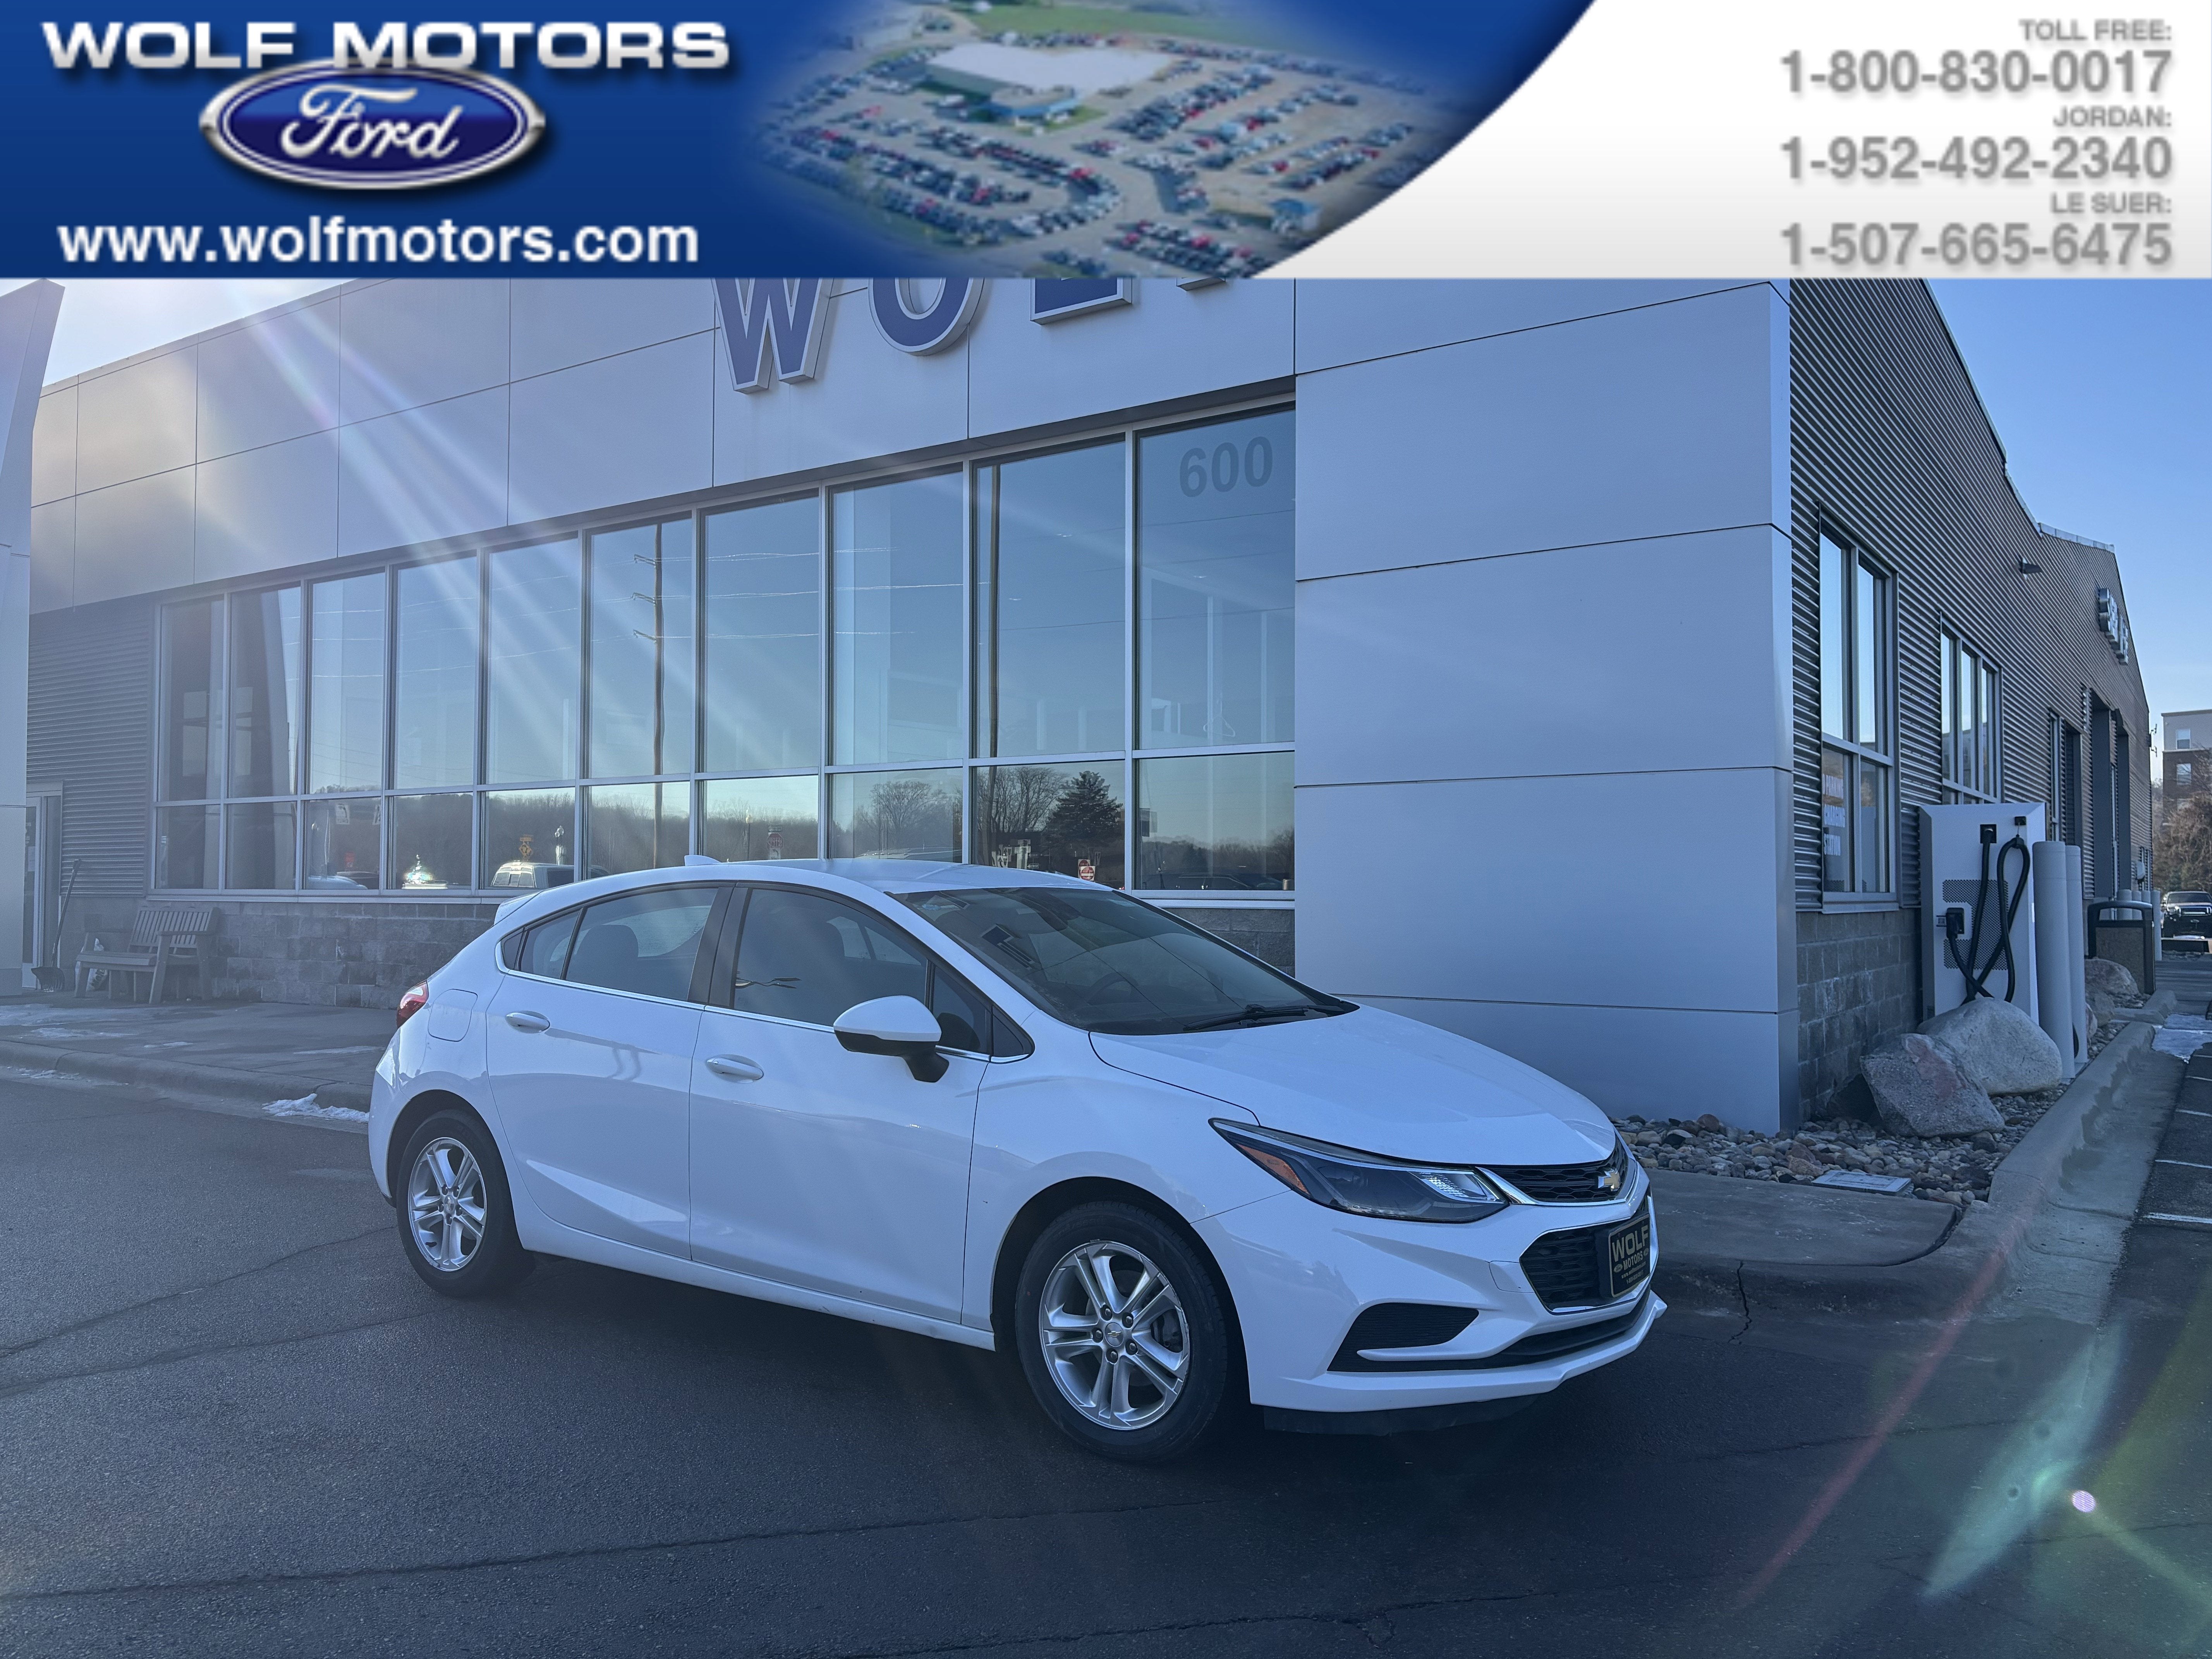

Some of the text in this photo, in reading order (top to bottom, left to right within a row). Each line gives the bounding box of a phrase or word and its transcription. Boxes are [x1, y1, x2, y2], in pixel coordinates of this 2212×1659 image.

[1180, 436, 1273, 497] 600
[1612, 1224, 1648, 1262] WOLF
[1623, 1251, 1644, 1271] MOTORS
